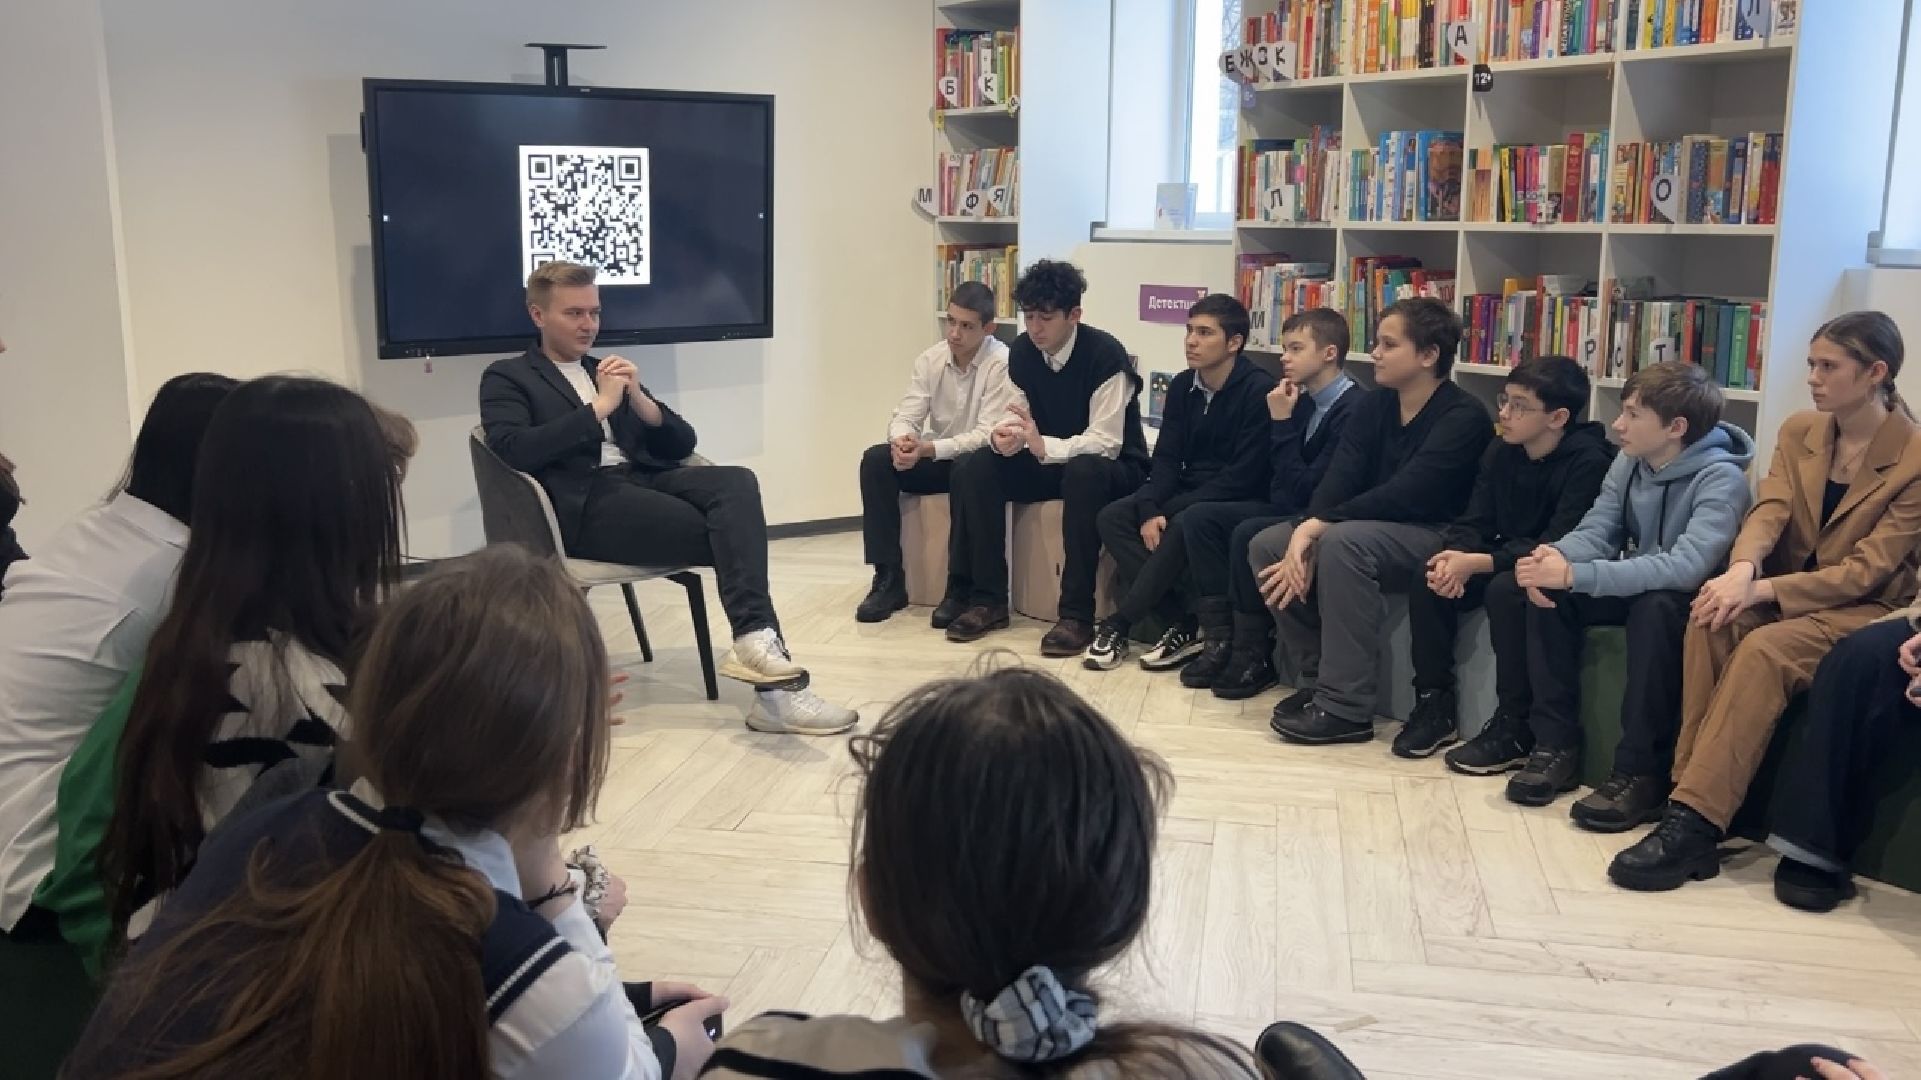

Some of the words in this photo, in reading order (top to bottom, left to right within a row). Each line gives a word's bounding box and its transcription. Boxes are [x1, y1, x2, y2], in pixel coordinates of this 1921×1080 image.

[1454, 25, 1468, 46] А
[1225, 54, 1235, 73] Е
[1240, 49, 1254, 68] Ж
[1275, 45, 1286, 66] К
[945, 79, 955, 95] Б
[984, 76, 994, 92] К
[1474, 72, 1492, 86] 12+
[918, 188, 932, 203] М
[993, 188, 1005, 202] Я
[1270, 188, 1283, 209] Л
[1655, 178, 1672, 202] О
[965, 192, 979, 209] Ф
[1250, 310, 1265, 329] М
[1585, 339, 1596, 361] Р
[1654, 343, 1666, 363] Т
